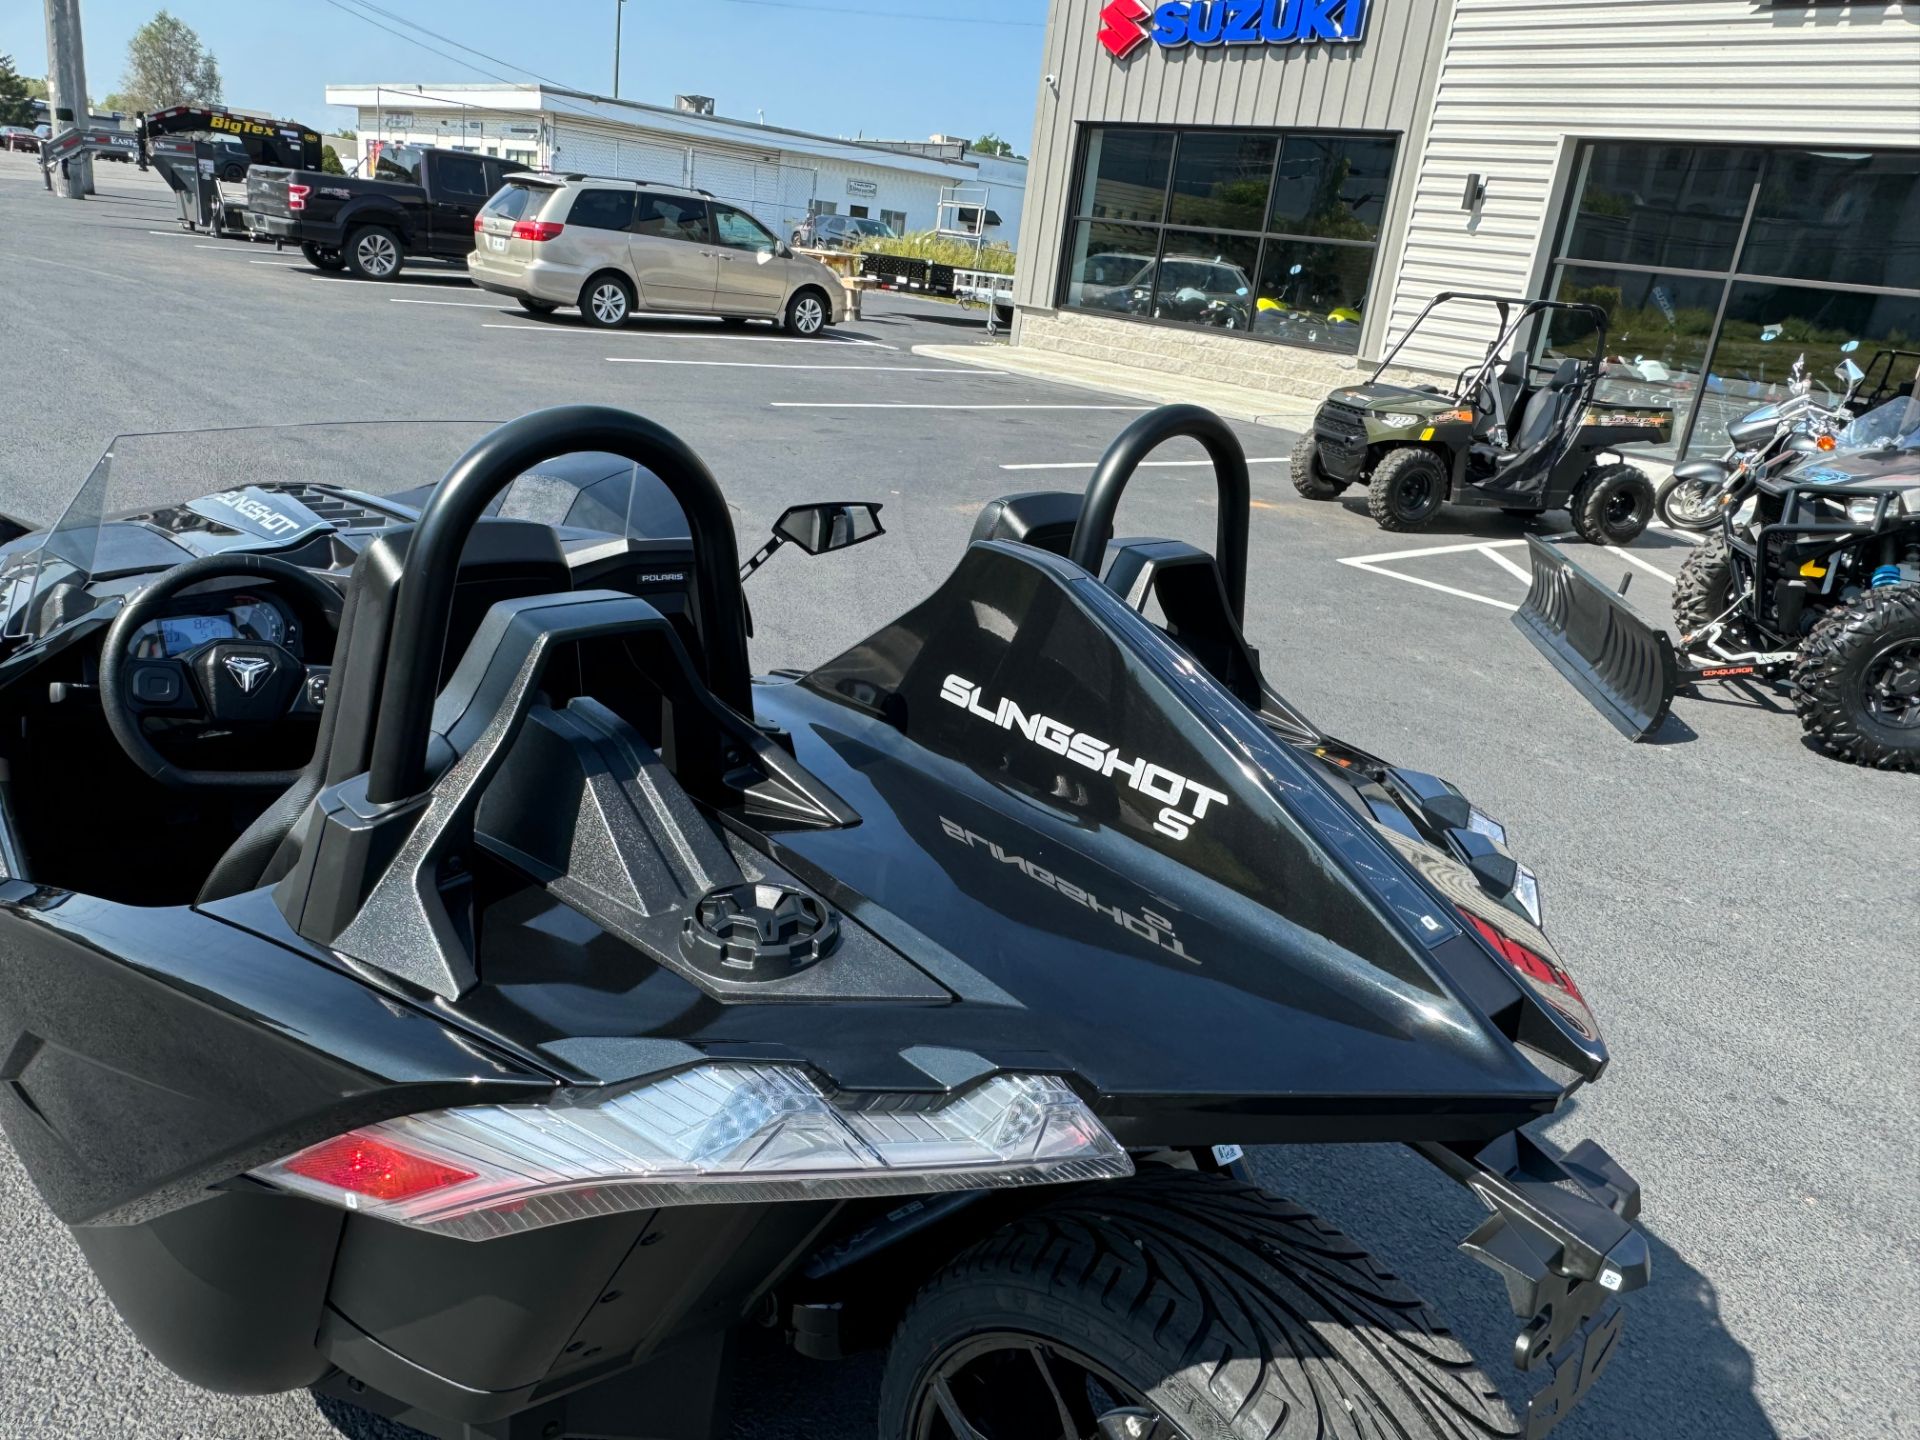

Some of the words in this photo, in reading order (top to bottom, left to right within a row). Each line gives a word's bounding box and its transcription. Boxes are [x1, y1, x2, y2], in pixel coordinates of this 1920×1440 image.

[1152, 0, 1363, 46] SUZUKI
[642, 573, 684, 582] POLARIS
[1703, 666, 1754, 677] CONQUEROR
[940, 674, 1229, 819] SLINGSHOT
[1153, 807, 1196, 841] S
